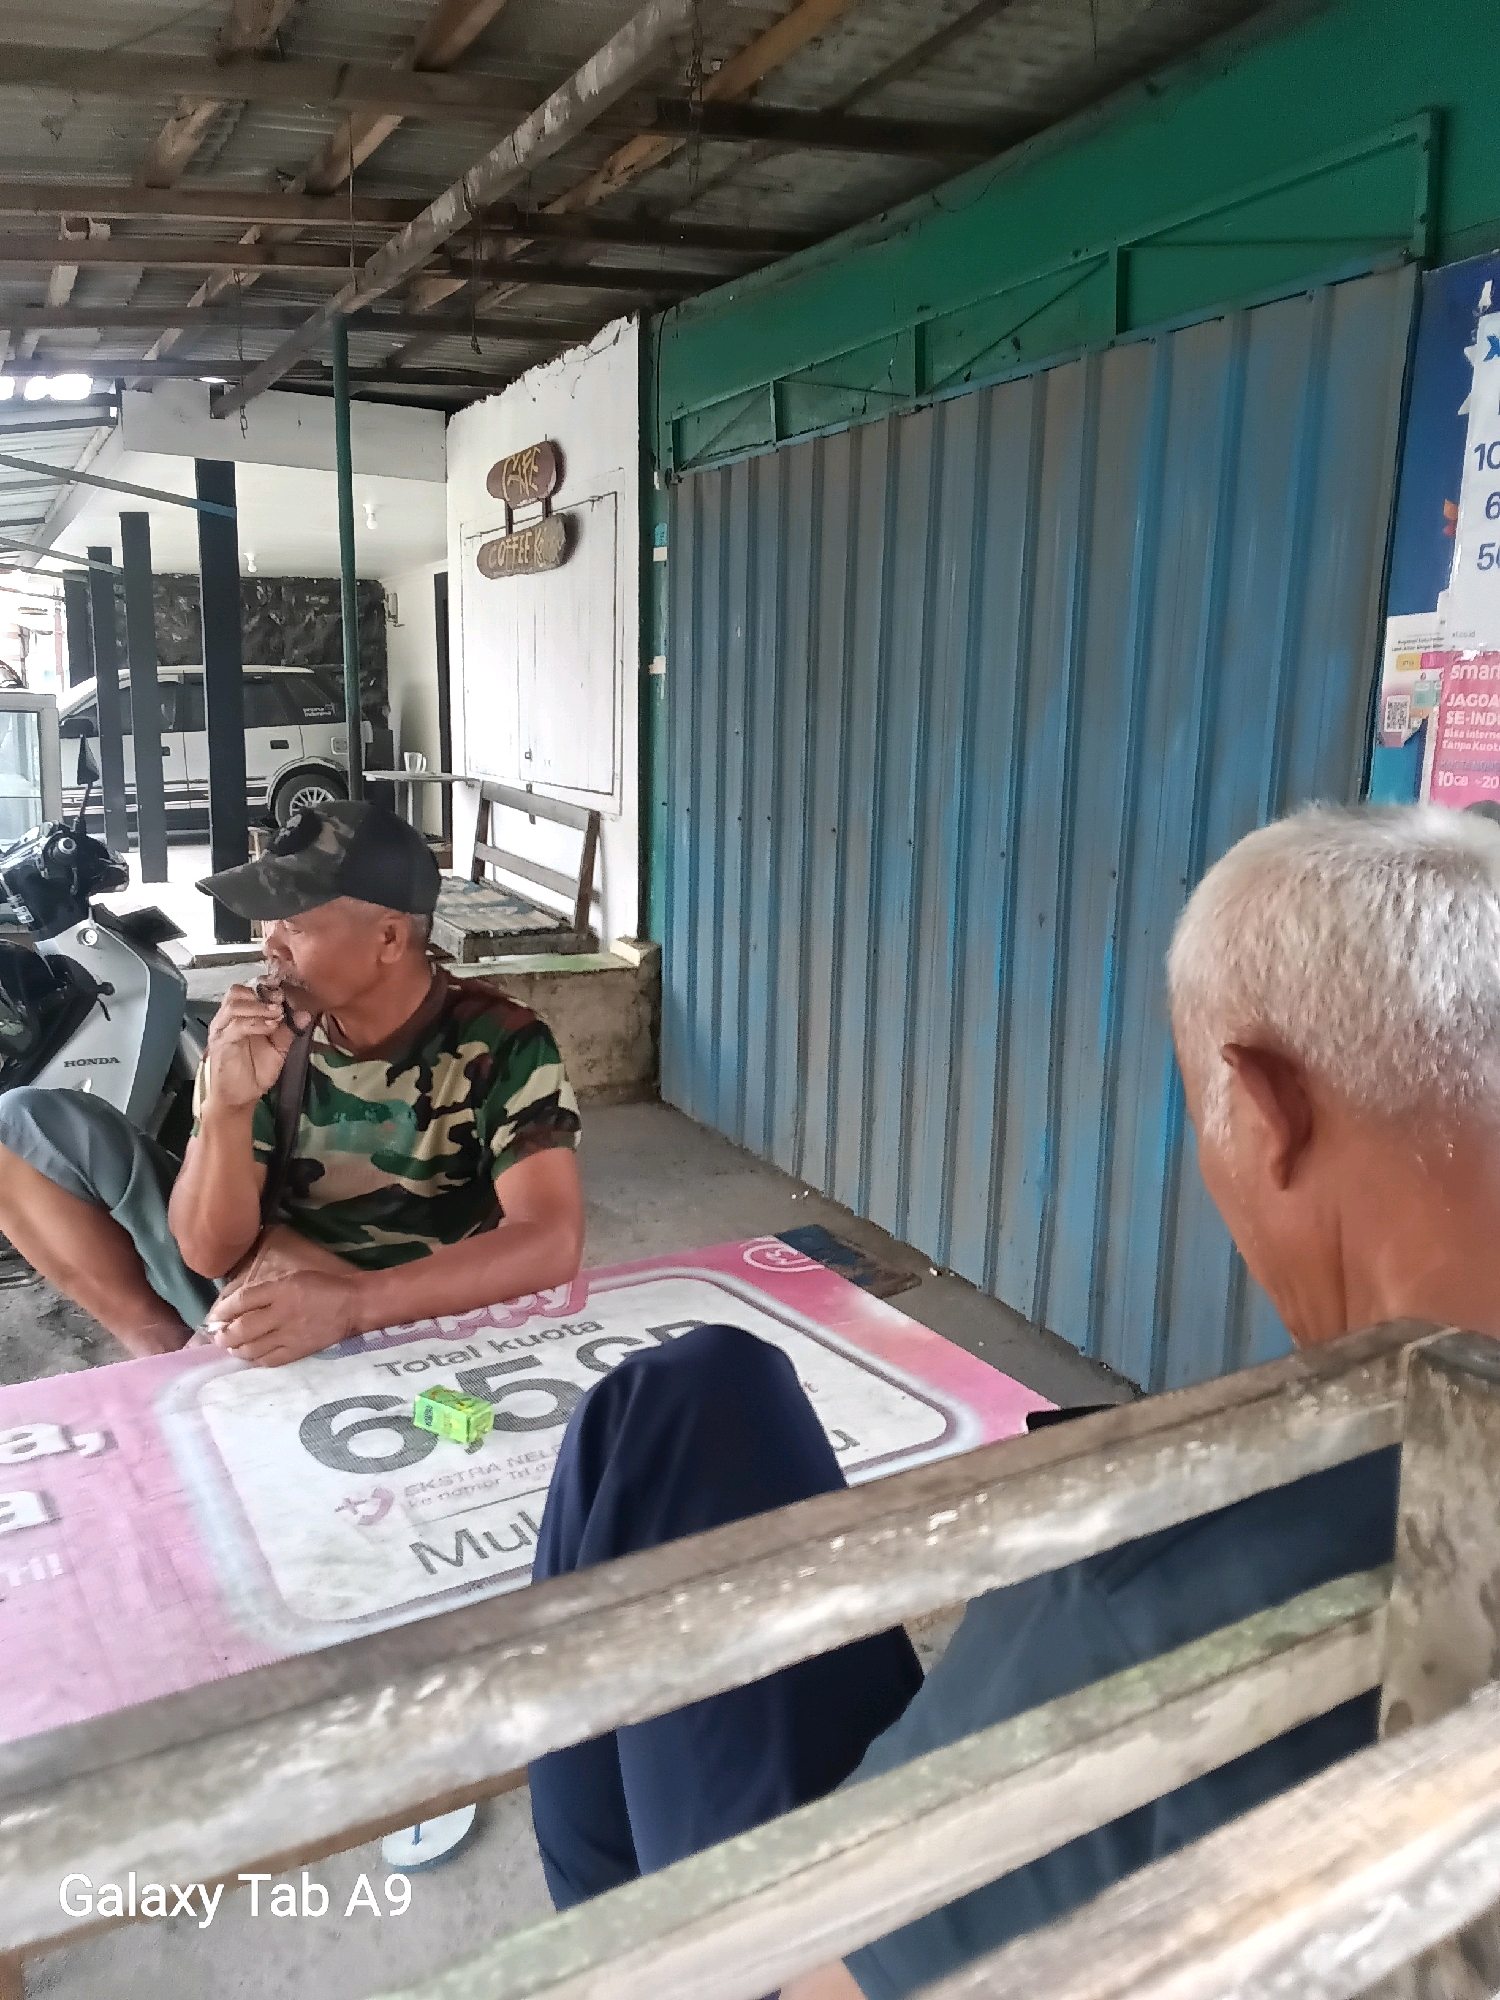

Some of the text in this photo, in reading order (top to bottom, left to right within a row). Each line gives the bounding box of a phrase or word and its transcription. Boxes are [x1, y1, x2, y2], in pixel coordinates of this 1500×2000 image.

[1446, 710, 1500, 725] SE-IND
[1472, 741, 1500, 752] Kuot
[63, 1056, 120, 1068] HONDA
[373, 1320, 605, 1377] Total kuota
[404, 1462, 501, 1498] EKSTRA
